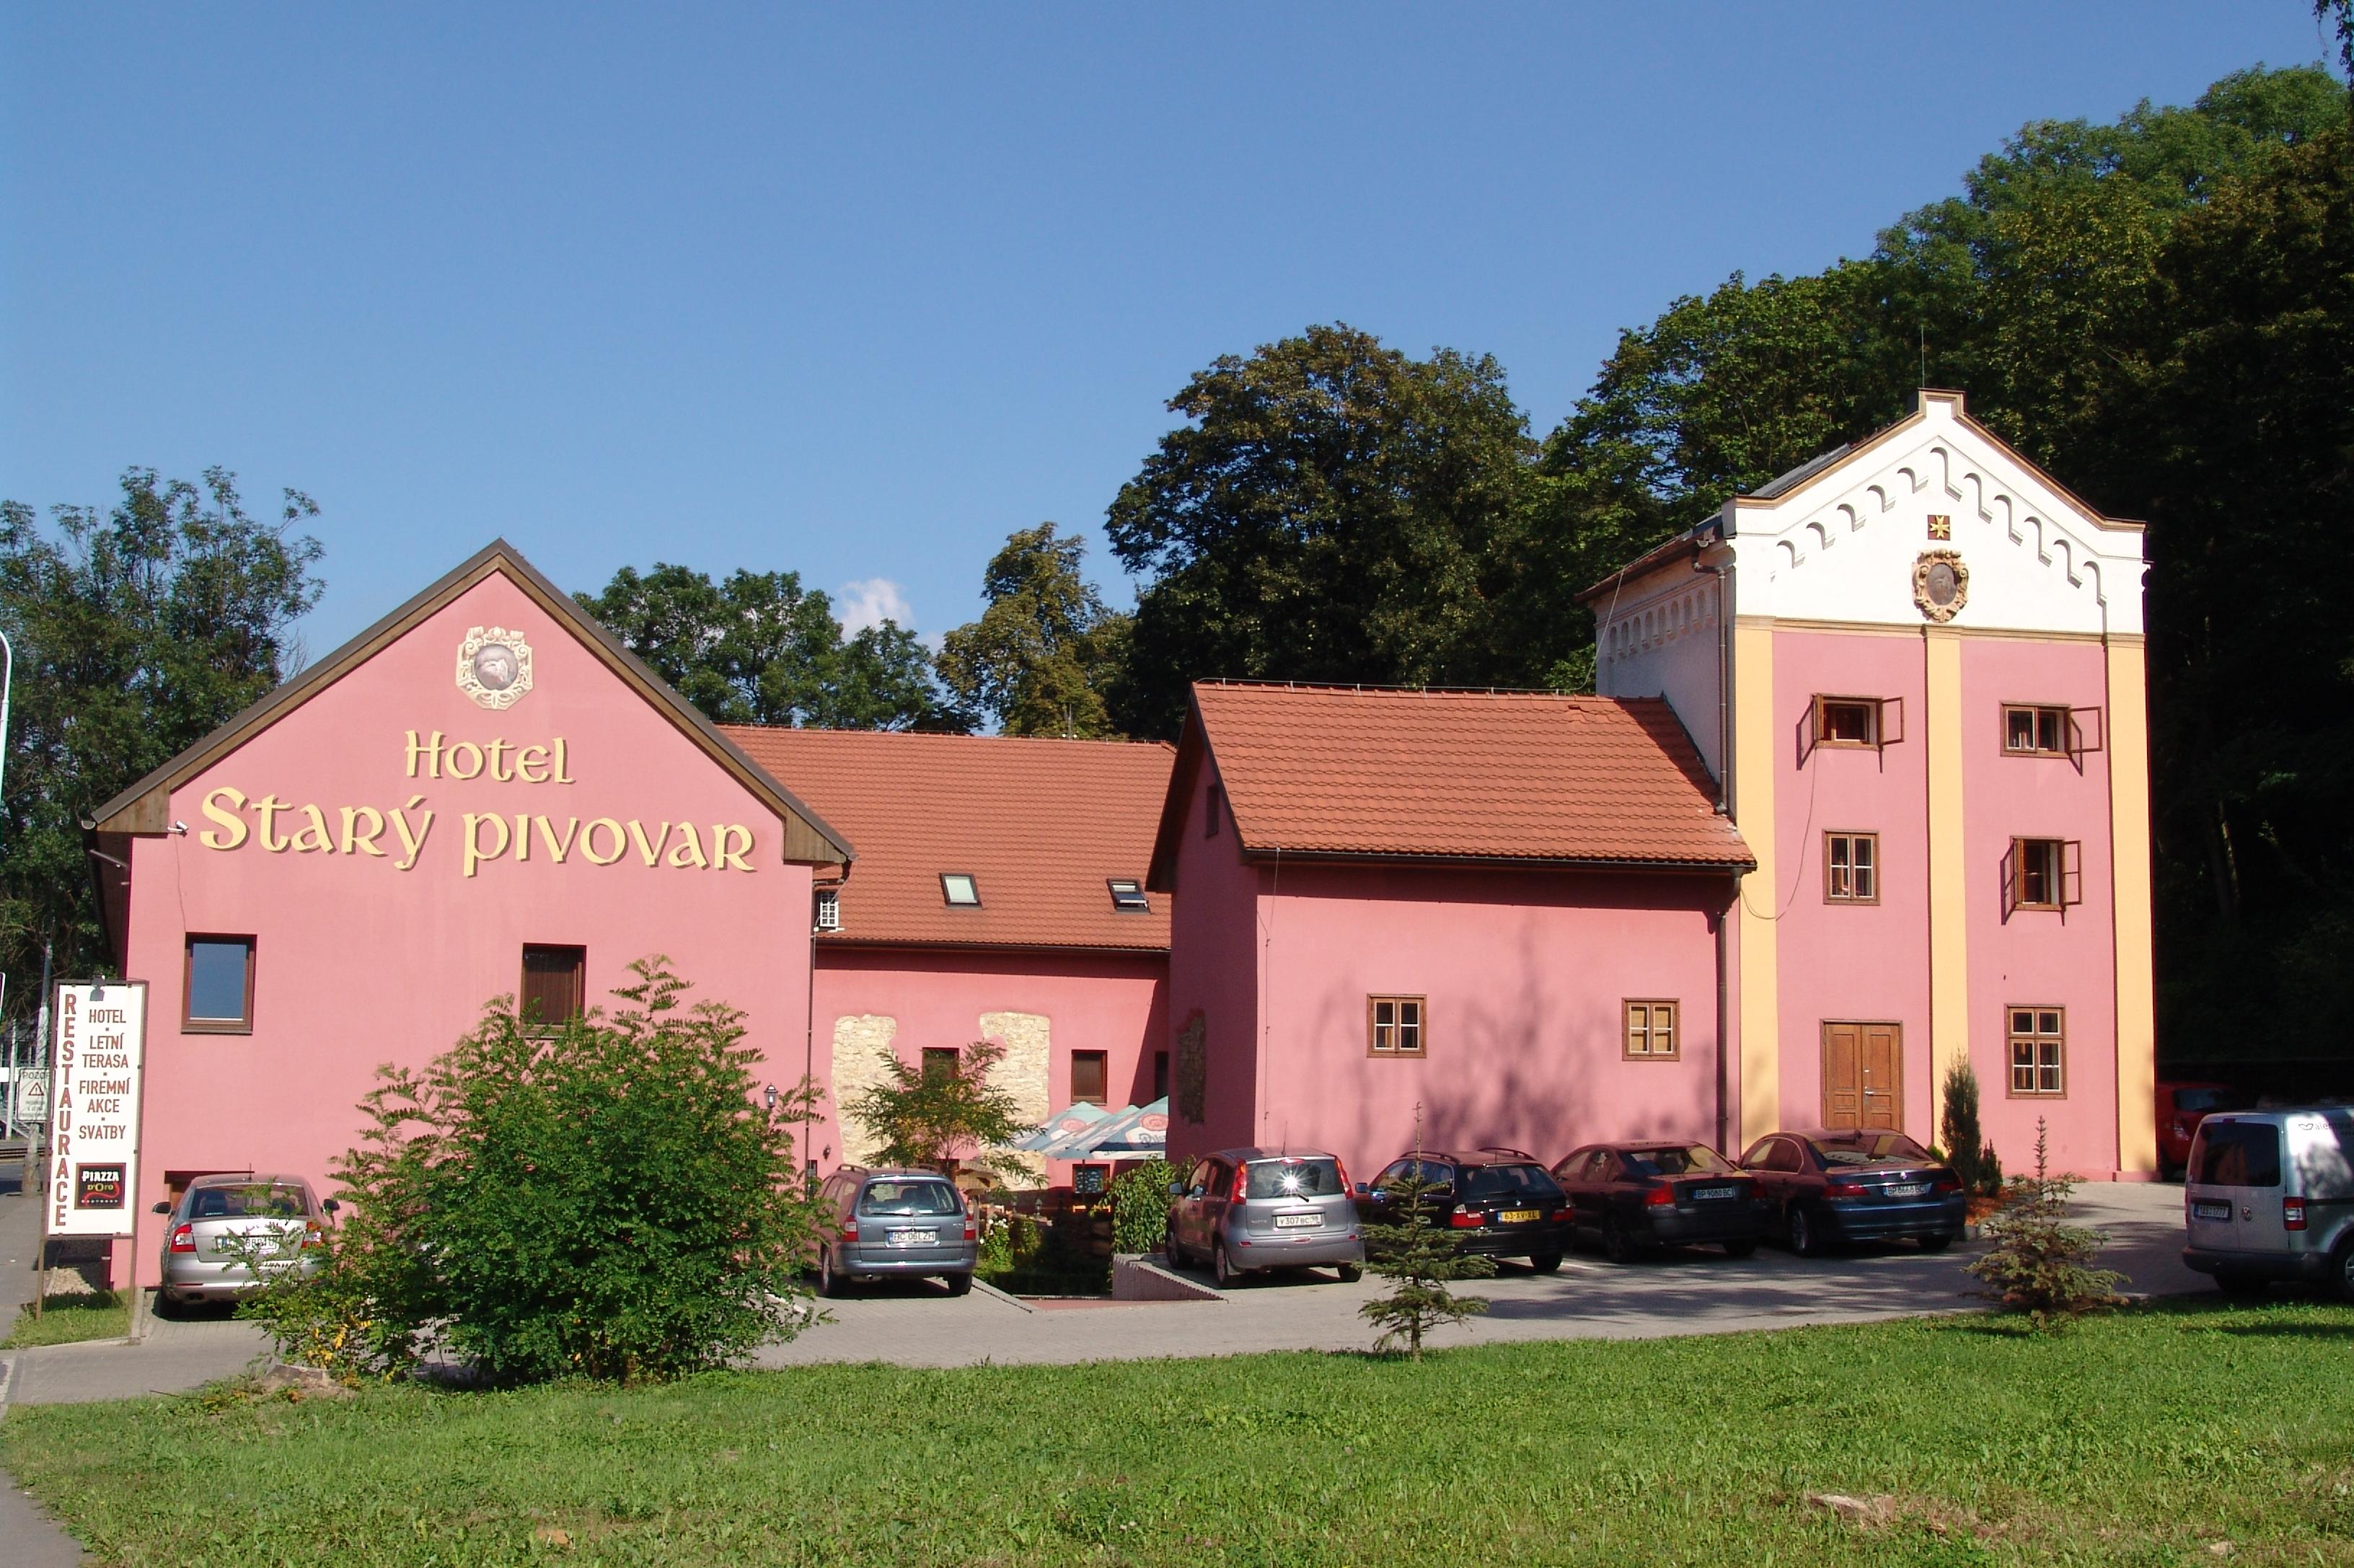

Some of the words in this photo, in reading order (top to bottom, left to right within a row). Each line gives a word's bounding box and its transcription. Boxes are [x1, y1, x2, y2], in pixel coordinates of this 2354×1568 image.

[405, 730, 576, 785] Hotel
[199, 786, 434, 871] Starý
[89, 1009, 126, 1023] HOTEL
[89, 1032, 124, 1049] LETNÍ
[81, 1054, 128, 1068] TERASA
[79, 1077, 131, 1094] FIREMNÍ
[54, 994, 76, 1227] RESTAURACE
[87, 1098, 120, 1113] AKCE
[79, 1125, 126, 1140] SVATBY
[81, 1171, 120, 1182] PIAZZA
